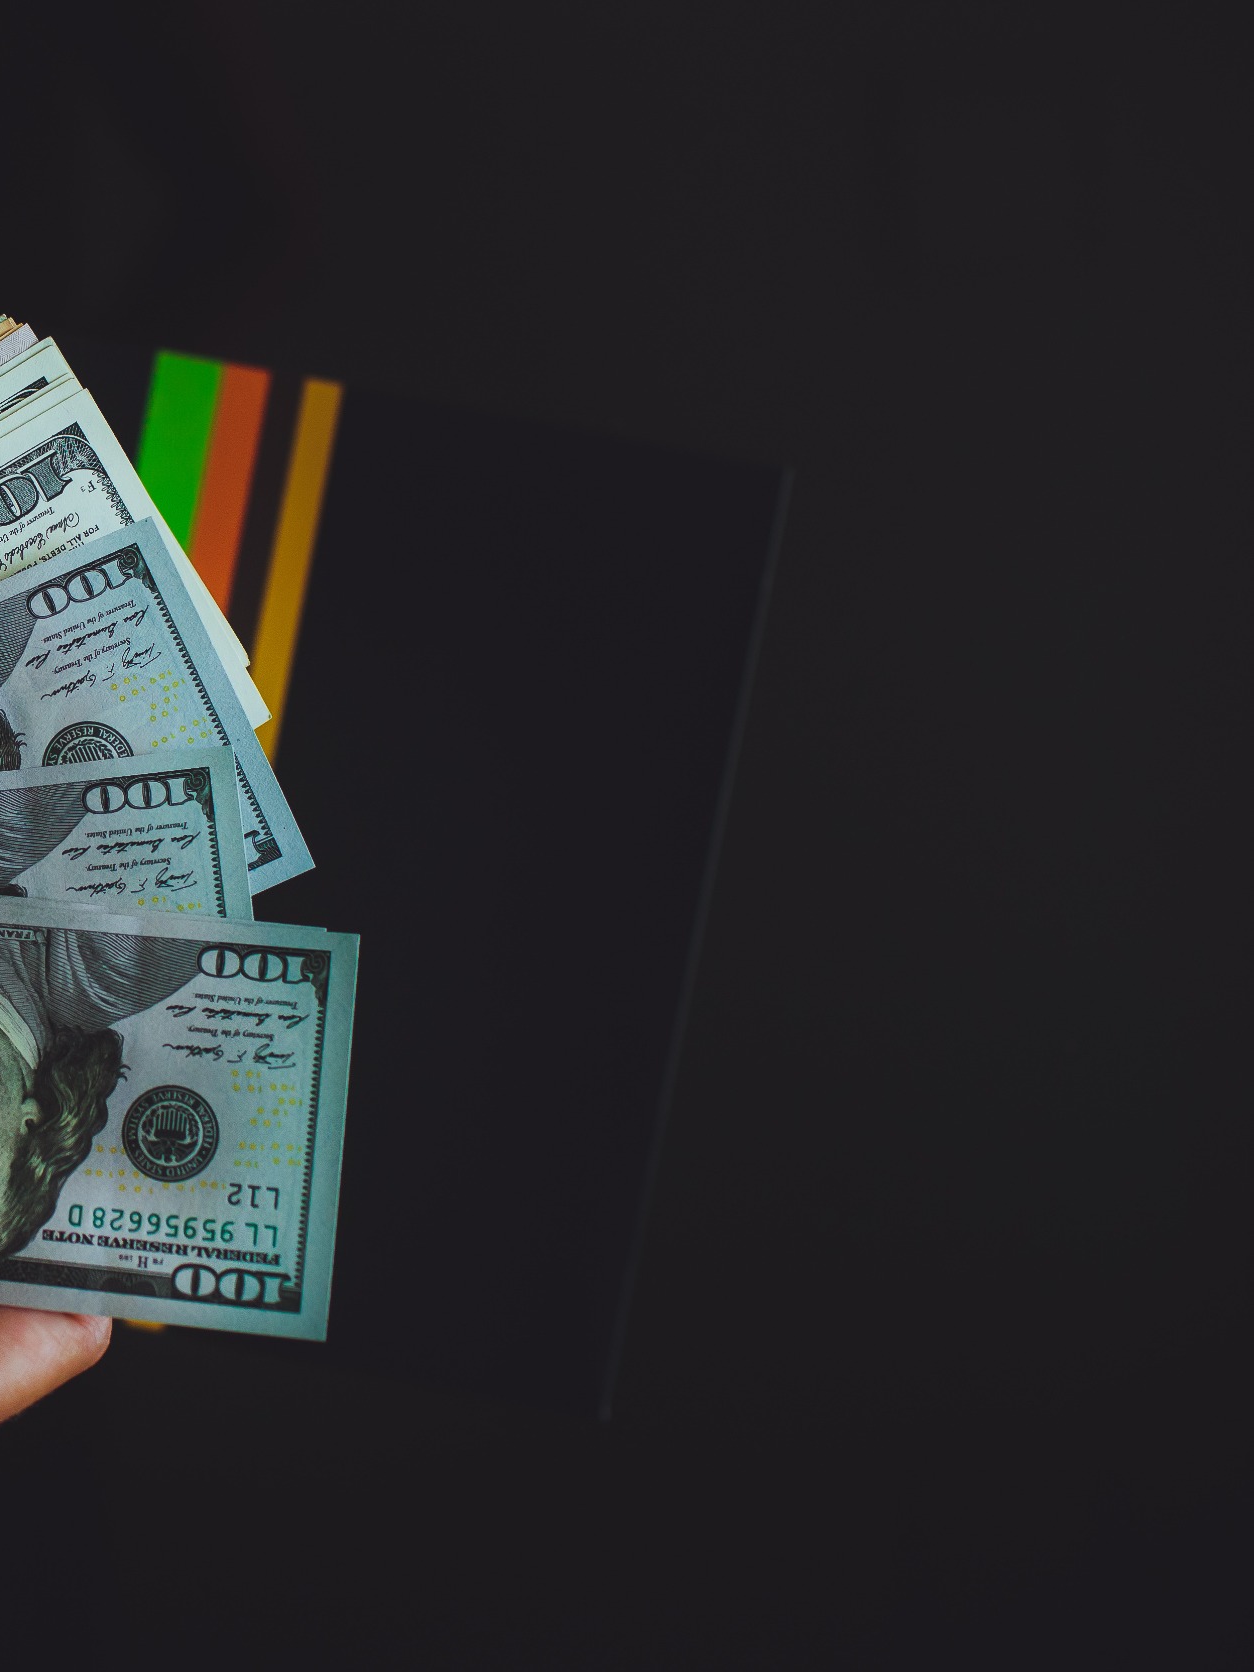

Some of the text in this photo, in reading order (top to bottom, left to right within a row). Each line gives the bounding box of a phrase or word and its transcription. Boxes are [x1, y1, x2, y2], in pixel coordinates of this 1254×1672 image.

[27, 507, 54, 526] Treasurer
[9, 528, 18, 536] the
[19, 522, 25, 532] of
[83, 525, 99, 537] FOR
[66, 534, 81, 546] ALL
[39, 544, 66, 562] DEBTS,
[26, 558, 133, 619] 100
[41, 600, 136, 644] Treasurer of the United States.
[101, 638, 131, 655] Secretary
[83, 653, 93, 663] the
[52, 659, 82, 675] Treasury.
[53, 726, 94, 749] RESERVE
[81, 776, 194, 815] 100
[84, 820, 188, 839] Treasurer of the United States.
[85, 857, 171, 872] Secretary of the Treasury.
[196, 944, 312, 985] 100
[218, 994, 241, 1004] United
[243, 1029, 274, 1042] Secretary
[152, 1091, 195, 1106] RESERVE
[226, 1183, 280, 1210] L12
[68, 1204, 278, 1248] LL 95956628 D
[41, 1229, 281, 1267] FEDERAL RESERVE NOTE
[137, 1255, 149, 1269] H
[171, 1263, 291, 1304] 100
